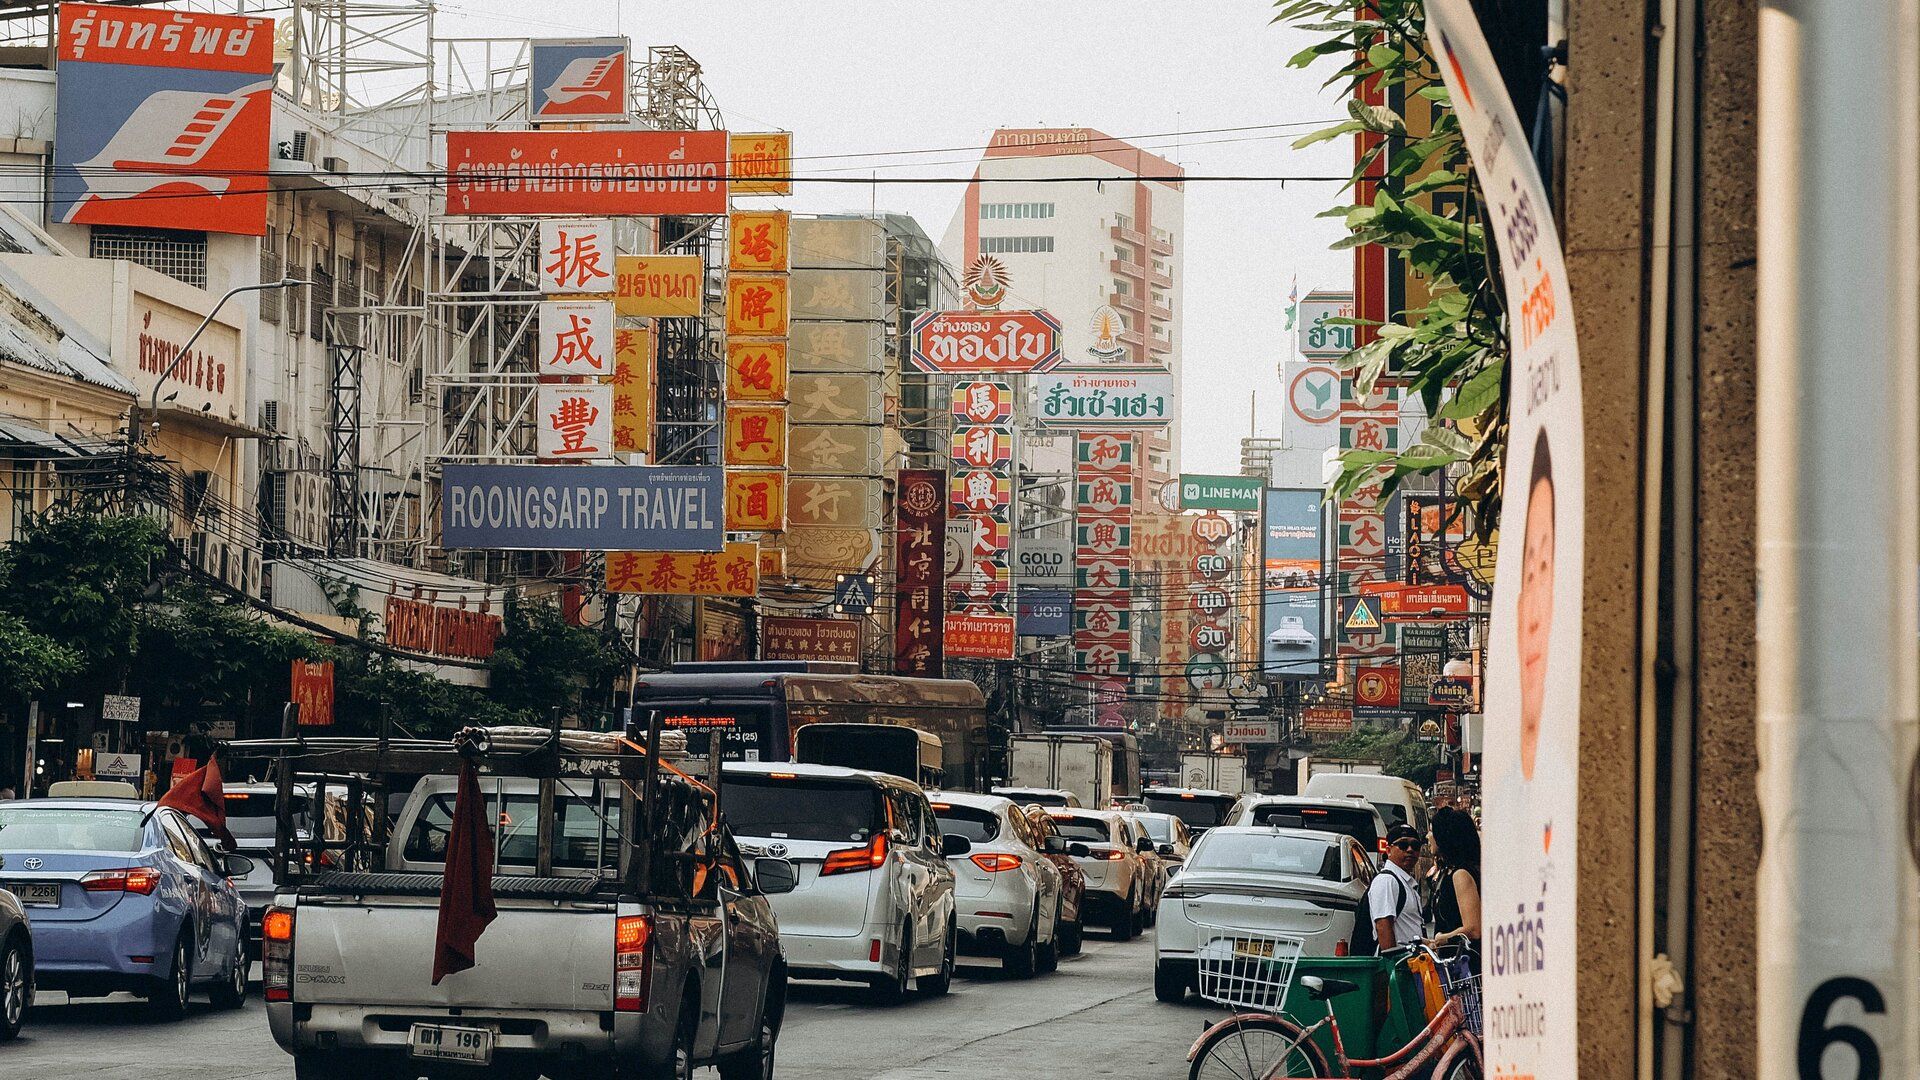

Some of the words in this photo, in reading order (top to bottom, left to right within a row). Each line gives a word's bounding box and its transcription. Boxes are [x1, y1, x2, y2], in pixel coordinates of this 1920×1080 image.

[70, 9, 263, 58] รุ่งทรัพย์
[457, 137, 717, 209] รุ่งทรัพย์การท่องเที่ยว
[931, 317, 991, 332] ห้างทอง
[929, 320, 1046, 363] ทองใบ
[1073, 375, 1137, 388] ห้างขายทอง
[1044, 380, 1164, 418] ฮั่วเซ่งเฮง
[451, 486, 608, 529] ROONGSARP
[618, 487, 714, 530] TRAVEL
[1020, 552, 1063, 565] GOLD
[1088, 438, 1121, 676] 和成興大金行
[1025, 565, 1058, 577] NOW
[1034, 606, 1062, 618] UOB
[1198, 626, 1225, 645] วัน
[817, 654, 855, 662] GOLDSMITH
[727, 733, 741, 741] 4-3
[742, 732, 758, 742] (25)
[32, 887, 56, 897] 2268
[1798, 976, 1886, 1080] 6
[456, 1032, 481, 1048] 196
